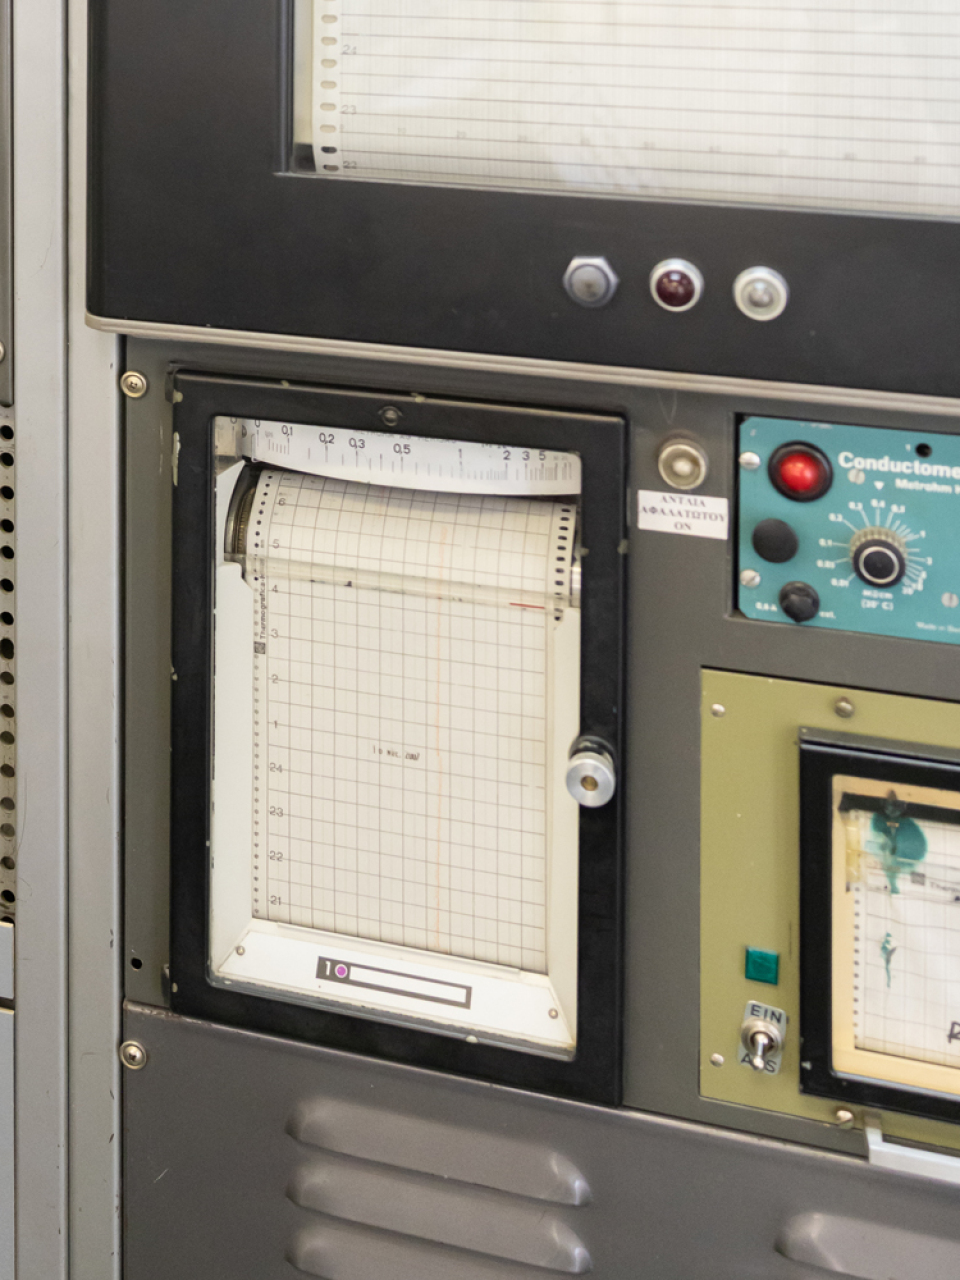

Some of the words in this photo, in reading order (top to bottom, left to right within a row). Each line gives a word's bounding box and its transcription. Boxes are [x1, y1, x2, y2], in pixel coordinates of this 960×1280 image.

[503, 450, 511, 461] 2
[522, 450, 530, 462] 3
[269, 762, 283, 773] 24
[269, 806, 284, 818] 23
[269, 850, 284, 862] 22
[269, 895, 282, 906] 21
[750, 1004, 783, 1024] EIN
